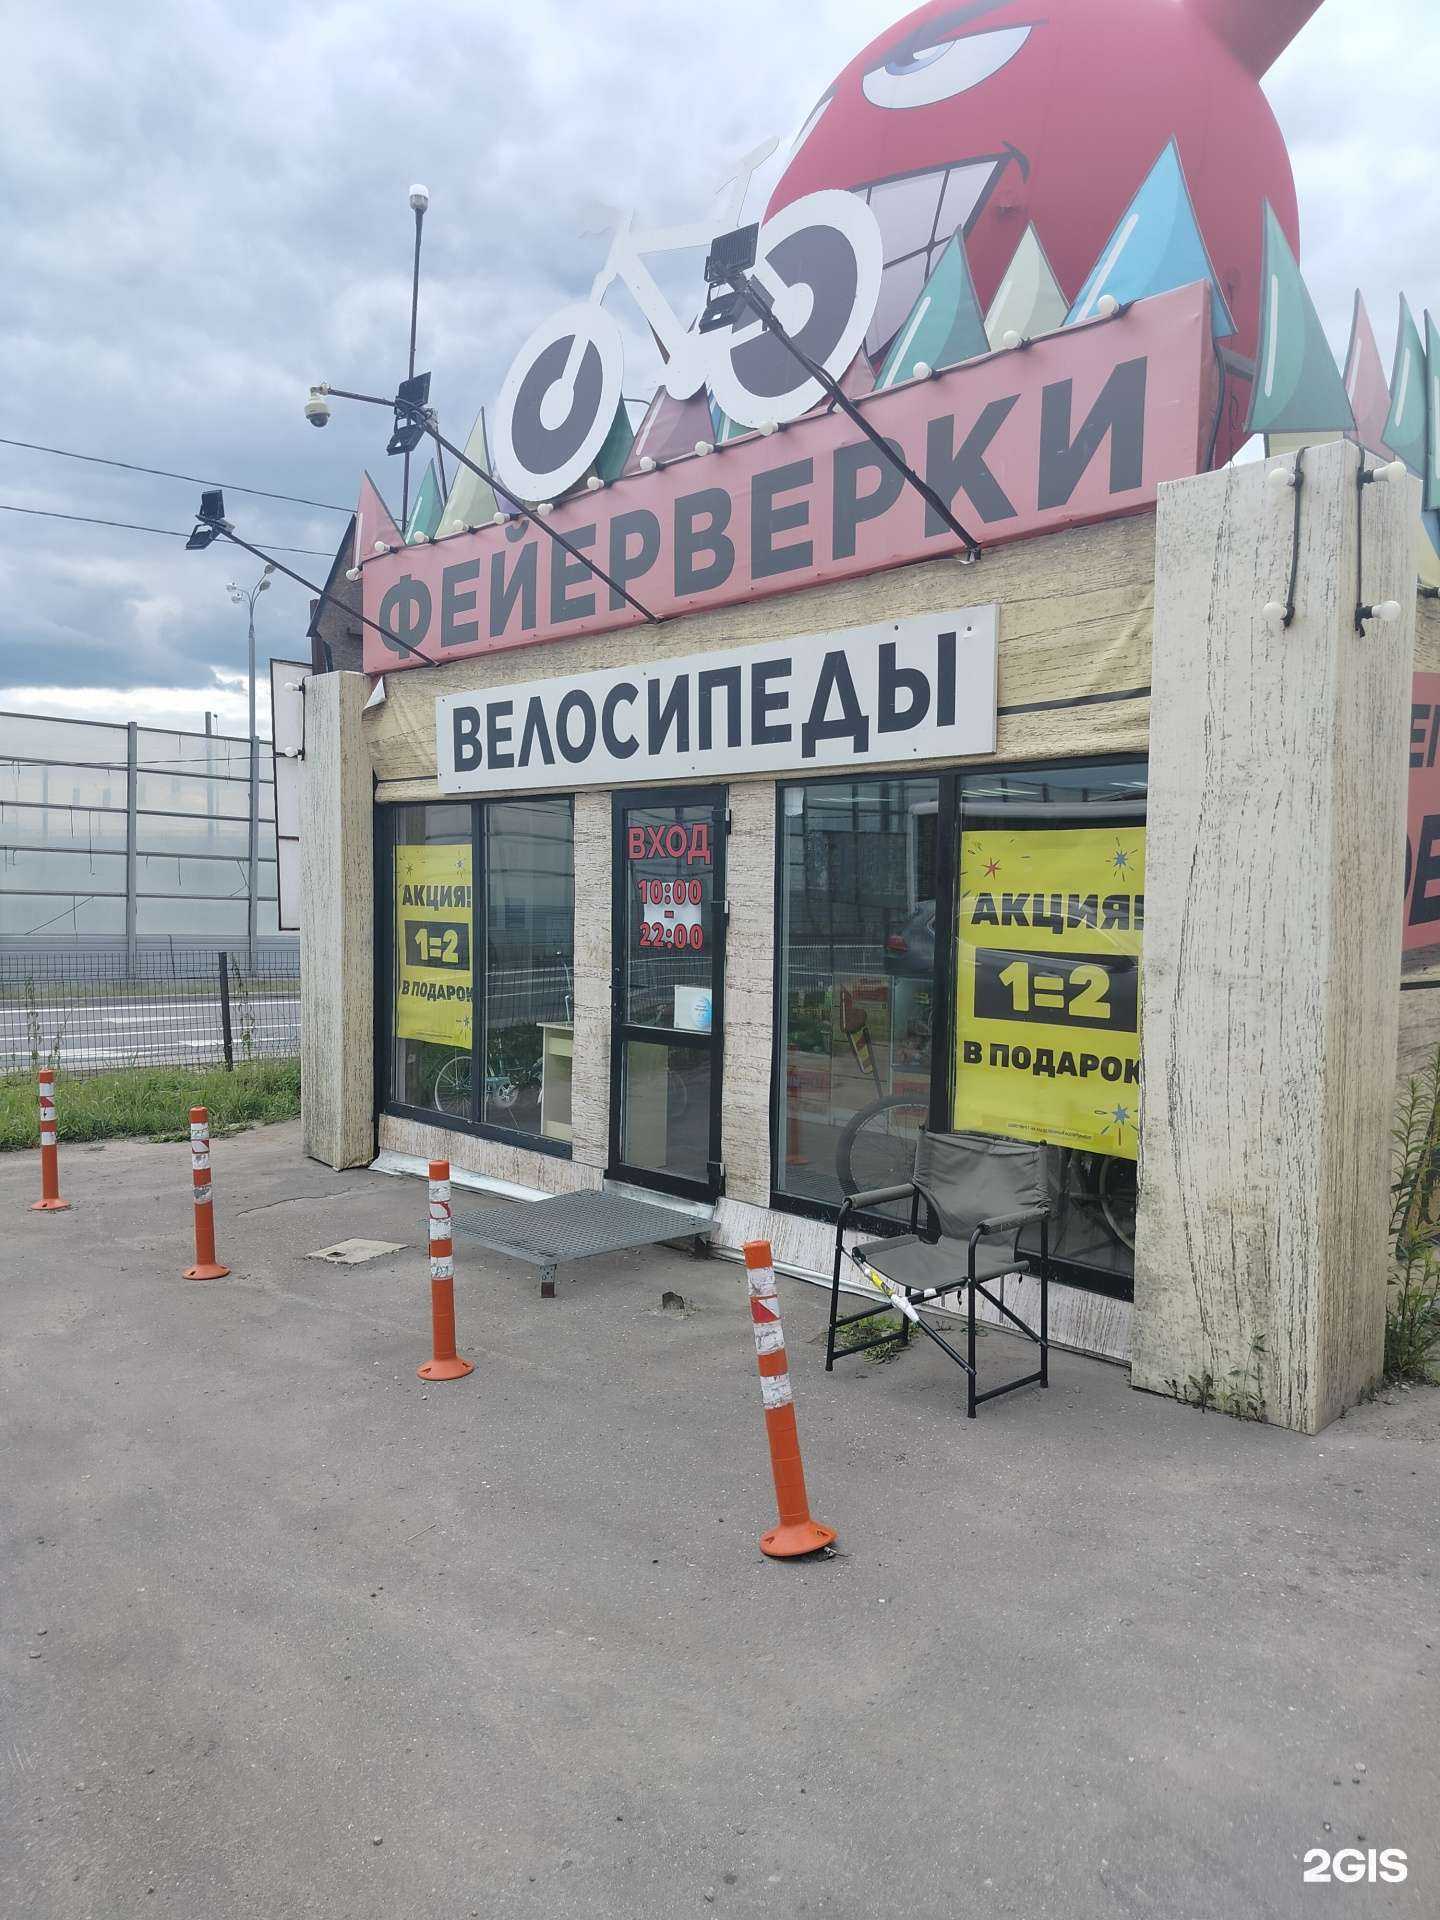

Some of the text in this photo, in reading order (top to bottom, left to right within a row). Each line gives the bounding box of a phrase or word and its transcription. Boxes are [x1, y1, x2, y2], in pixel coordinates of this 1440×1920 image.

[378, 355, 1147, 658] ФЕЙЕРВЕРКИ
[452, 631, 957, 772] ВЕЛОСИПЕДЫ
[627, 823, 712, 865] ВХОД
[402, 884, 472, 911] АКЦИЯ!
[637, 879, 703, 906] 10:00
[415, 928, 459, 963] 1=2
[639, 922, 704, 949] 22:00
[401, 980, 410, 995] В
[998, 960, 1111, 1019] 1=2
[963, 1041, 1140, 1085] В ПОДАРОК
